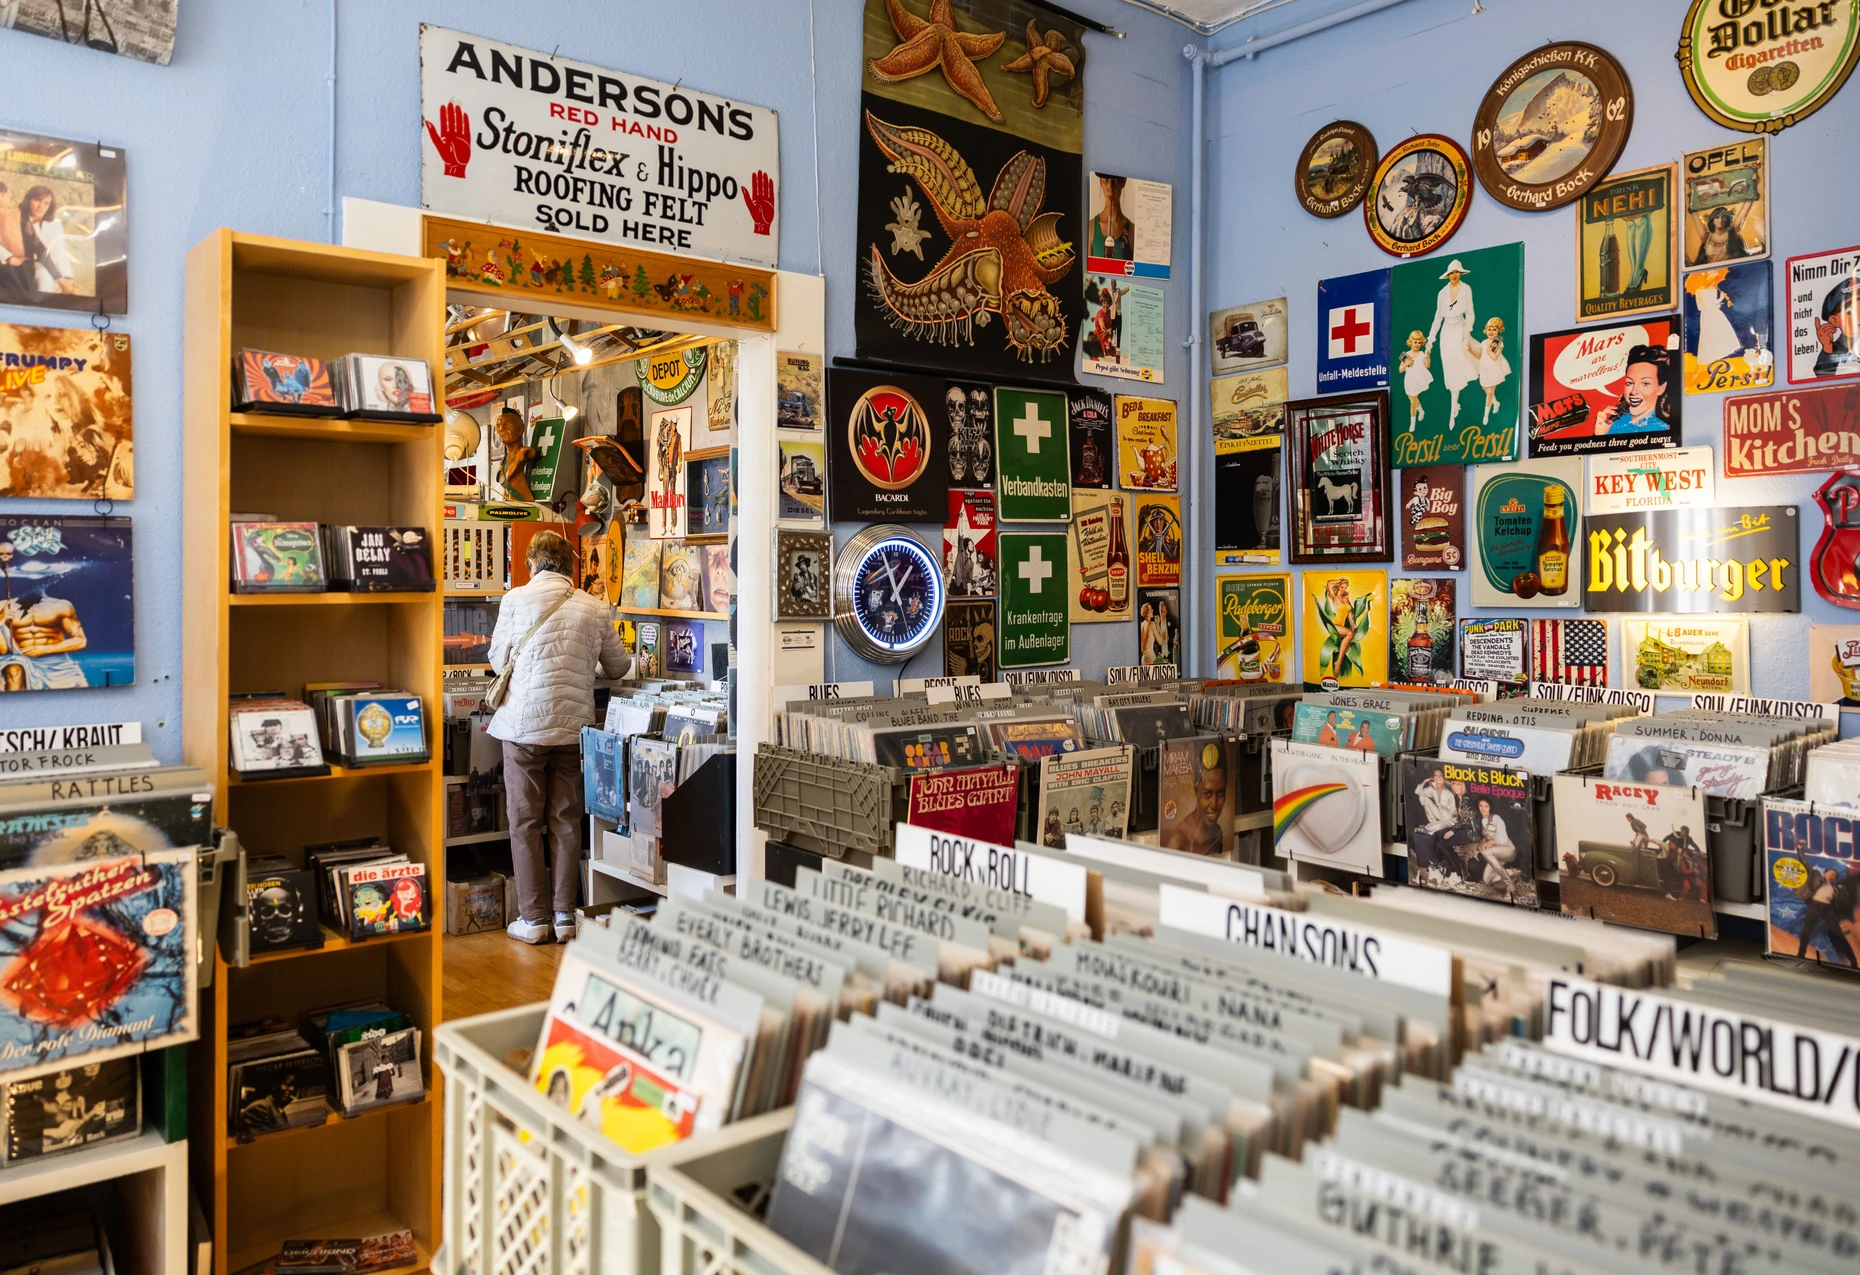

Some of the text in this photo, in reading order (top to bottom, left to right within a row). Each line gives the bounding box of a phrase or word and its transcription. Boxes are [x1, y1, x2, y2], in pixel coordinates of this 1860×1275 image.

[1707, 0, 1840, 59] Dollar
[1725, 36, 1825, 71] Cigaretten
[1496, 50, 1571, 97] Königschießen
[446, 41, 754, 141] ANDERSON'S
[1606, 97, 1626, 121] 62
[550, 102, 678, 144] RED HAND
[1476, 128, 1492, 150] 19
[476, 106, 738, 201] Stoniflex & Hippo
[1688, 146, 1760, 173] OPEL
[1507, 168, 1594, 203] Gerhard Bock
[1610, 183, 1640, 196] DRINK
[513, 165, 708, 226] ROOFING FELT
[1341, 182, 1364, 208] Bock
[1593, 188, 1657, 218] NEHI
[535, 204, 692, 249] SOLD HERE
[1391, 233, 1442, 251] Gerhard Bock
[1792, 258, 1851, 283] Nimm Dir
[1585, 293, 1664, 315] QUALITY BEVERAGES
[1798, 290, 1813, 304] und
[1794, 307, 1813, 320] nicht
[1794, 326, 1808, 338] das
[1095, 363, 1108, 373] Pepsi
[1591, 354, 1607, 365] are
[652, 360, 680, 381] DEPOT
[1319, 365, 1387, 383] Unfall-Meldestelle
[1696, 359, 1772, 390] Persil
[1121, 401, 1143, 419] BED &
[1138, 412, 1172, 422] BREAKFAST
[1537, 393, 1583, 426] Mars
[1730, 396, 1801, 435] MOM'S
[1537, 421, 1560, 437] Mars
[1219, 438, 1274, 448] EINKAUFSZETTEL
[1310, 422, 1365, 464] WHITE HORSE
[1394, 426, 1514, 465] Persil Persil
[1537, 436, 1671, 454] Feeds you goodness three good ways
[1331, 458, 1367, 466] Whisky
[1333, 449, 1364, 458] Scotch
[1620, 452, 1678, 463] SOUTHERNMOST
[1807, 455, 1854, 467] Fresh Daily
[1640, 461, 1657, 469] CITY
[1002, 474, 1068, 499] Verbandkasten
[1594, 469, 1707, 495] KEY WEST
[875, 493, 909, 502] BACARDI
[1430, 487, 1453, 505] Big
[1625, 496, 1673, 507] FLORIDA
[787, 506, 814, 514] DIESEL
[857, 507, 885, 516] Legendary
[1430, 501, 1458, 516] Boy
[8, 518, 62, 527] OCEAN
[1494, 516, 1532, 526] Tomaten
[360, 532, 384, 548] JAN
[1494, 526, 1532, 537] Ketchup
[355, 547, 390, 563] DELAY
[1139, 552, 1166, 564] SHELL
[1407, 553, 1442, 567] Burgers
[1587, 526, 1790, 602] Bitburger
[1147, 563, 1180, 575] BENZIN
[1225, 583, 1246, 592] BEER
[1223, 593, 1283, 620] Radeberger
[1007, 610, 1064, 632] Krankentrage
[1464, 619, 1520, 634] PUNK PARK
[948, 627, 973, 642] ROCK
[1004, 633, 1065, 652] im Außenlager
[1470, 637, 1513, 645] DESCENDENTS
[1109, 665, 1176, 684] SOUL/FUNK/DISCO
[1680, 675, 1729, 689] Neundorf
[808, 684, 840, 700] BLUES
[953, 685, 981, 701] BLUES
[1131, 695, 1152, 705] ROLLERS
[1535, 683, 1651, 714] SOUL/FUNK/DISCO
[1363, 699, 1391, 710] GRACE
[1694, 695, 1823, 720] SOUL/FUNK/DISCO
[890, 712, 959, 727] BLUES THE
[1513, 716, 1537, 726] OTIS
[63, 725, 123, 749] KRAUT
[1700, 731, 1742, 744] DONNA
[904, 741, 949, 758] OSCAR
[1686, 749, 1743, 763] STEADY
[37, 753, 96, 769] FROCK
[1048, 755, 1128, 774] BLUES BREAKERS
[1163, 762, 1194, 774] MAKEBA
[1047, 771, 1128, 790] WITH ERIC CLAPTON
[1056, 765, 1121, 781] JOHN MAYALL
[1443, 765, 1524, 788] Black Is Black
[51, 775, 155, 800] RATTLES
[1470, 784, 1525, 799] Belle Epoque
[1594, 783, 1660, 806] RACEY
[916, 786, 1014, 814] BLUES GIANT
[1595, 800, 1619, 808] SMASH
[353, 864, 420, 883] die ärzte
[930, 833, 1033, 898] ROCK ROLL
[1225, 903, 1381, 978] CHANSONS
[79, 1014, 156, 1044] Diamant
